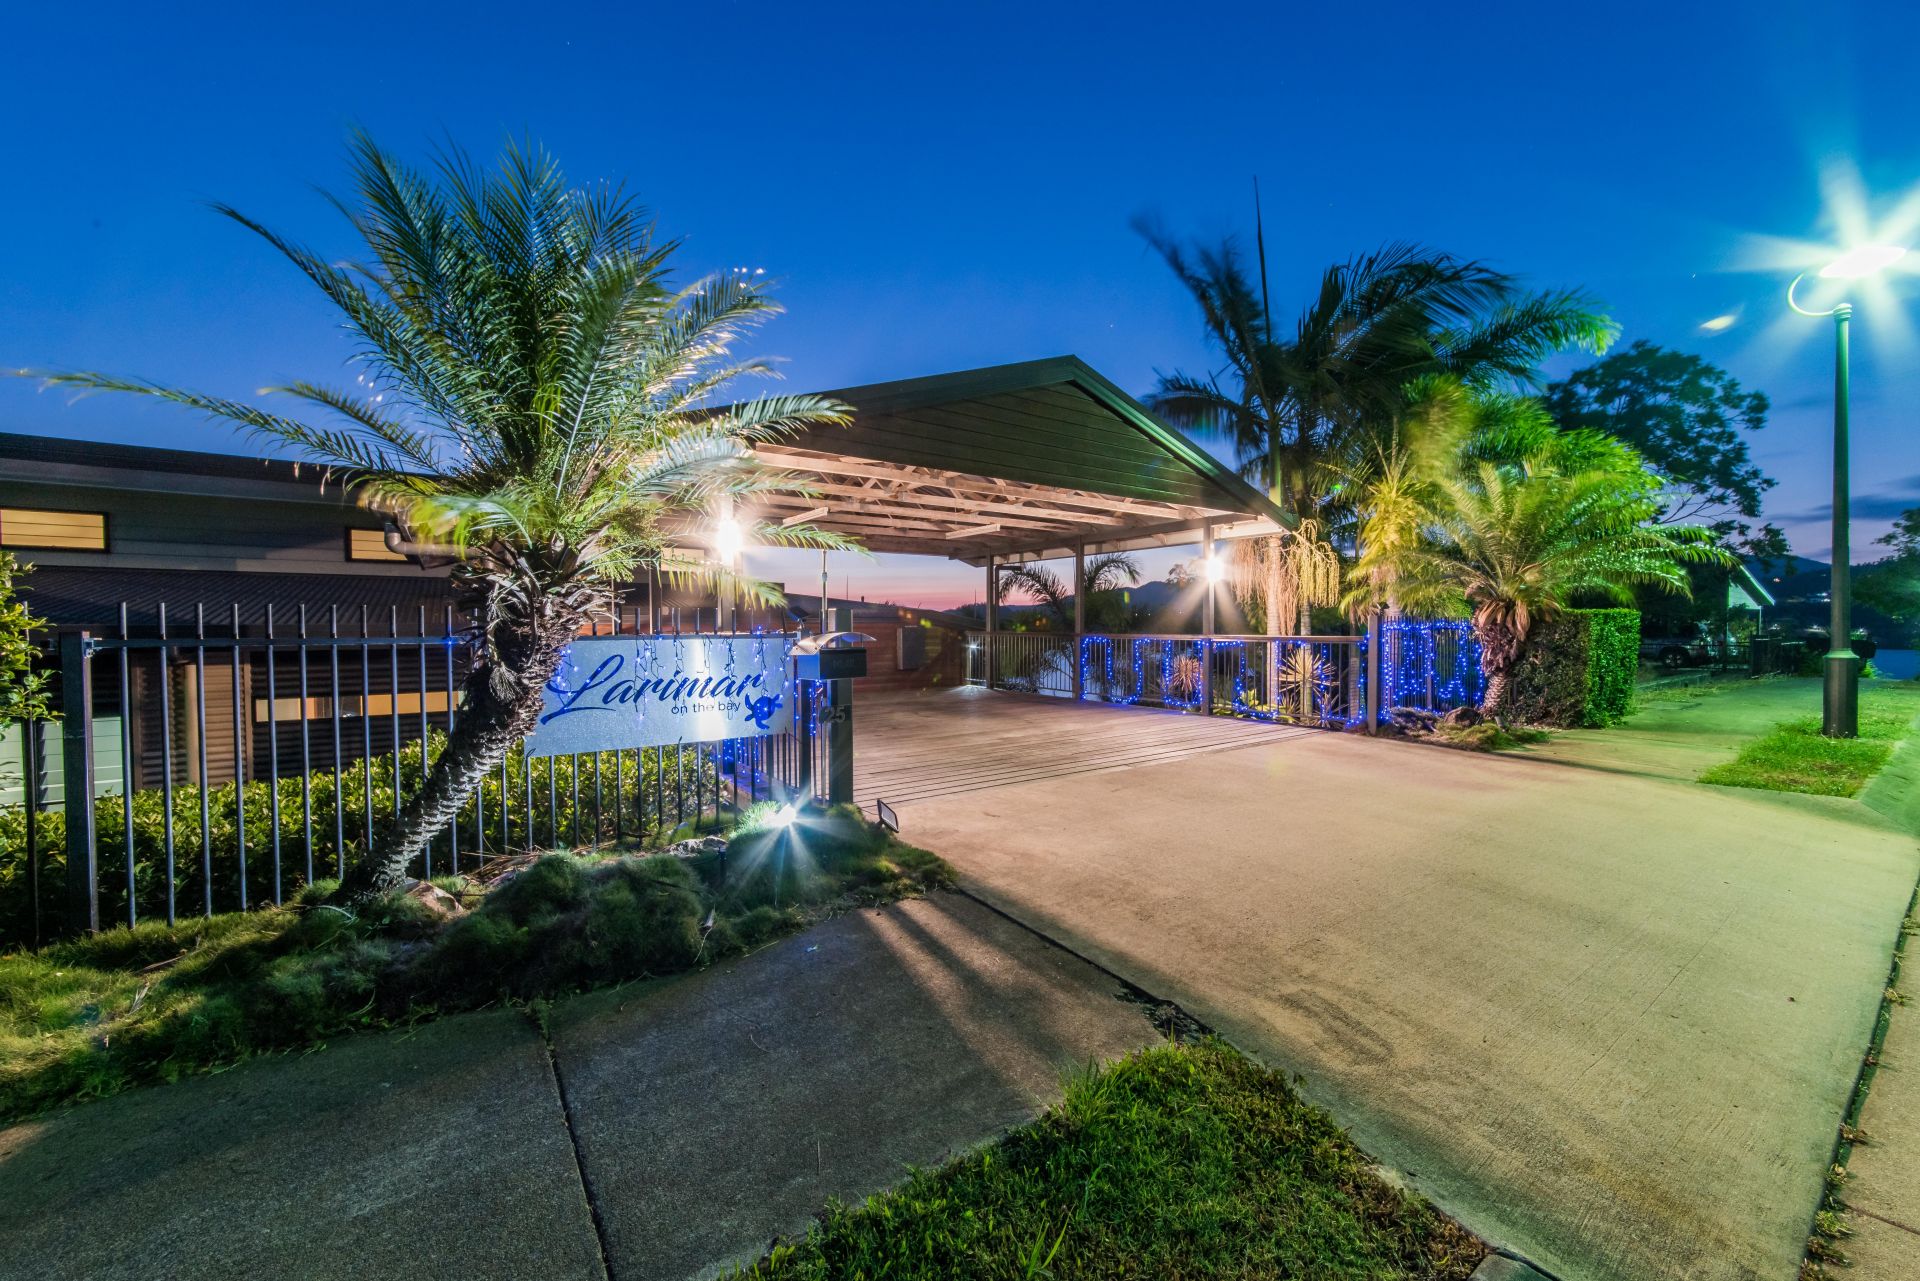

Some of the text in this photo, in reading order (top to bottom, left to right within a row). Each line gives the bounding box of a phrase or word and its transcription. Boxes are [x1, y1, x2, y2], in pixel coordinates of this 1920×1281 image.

[540, 654, 763, 725] Larimar
[671, 701, 741, 715] on the bay
